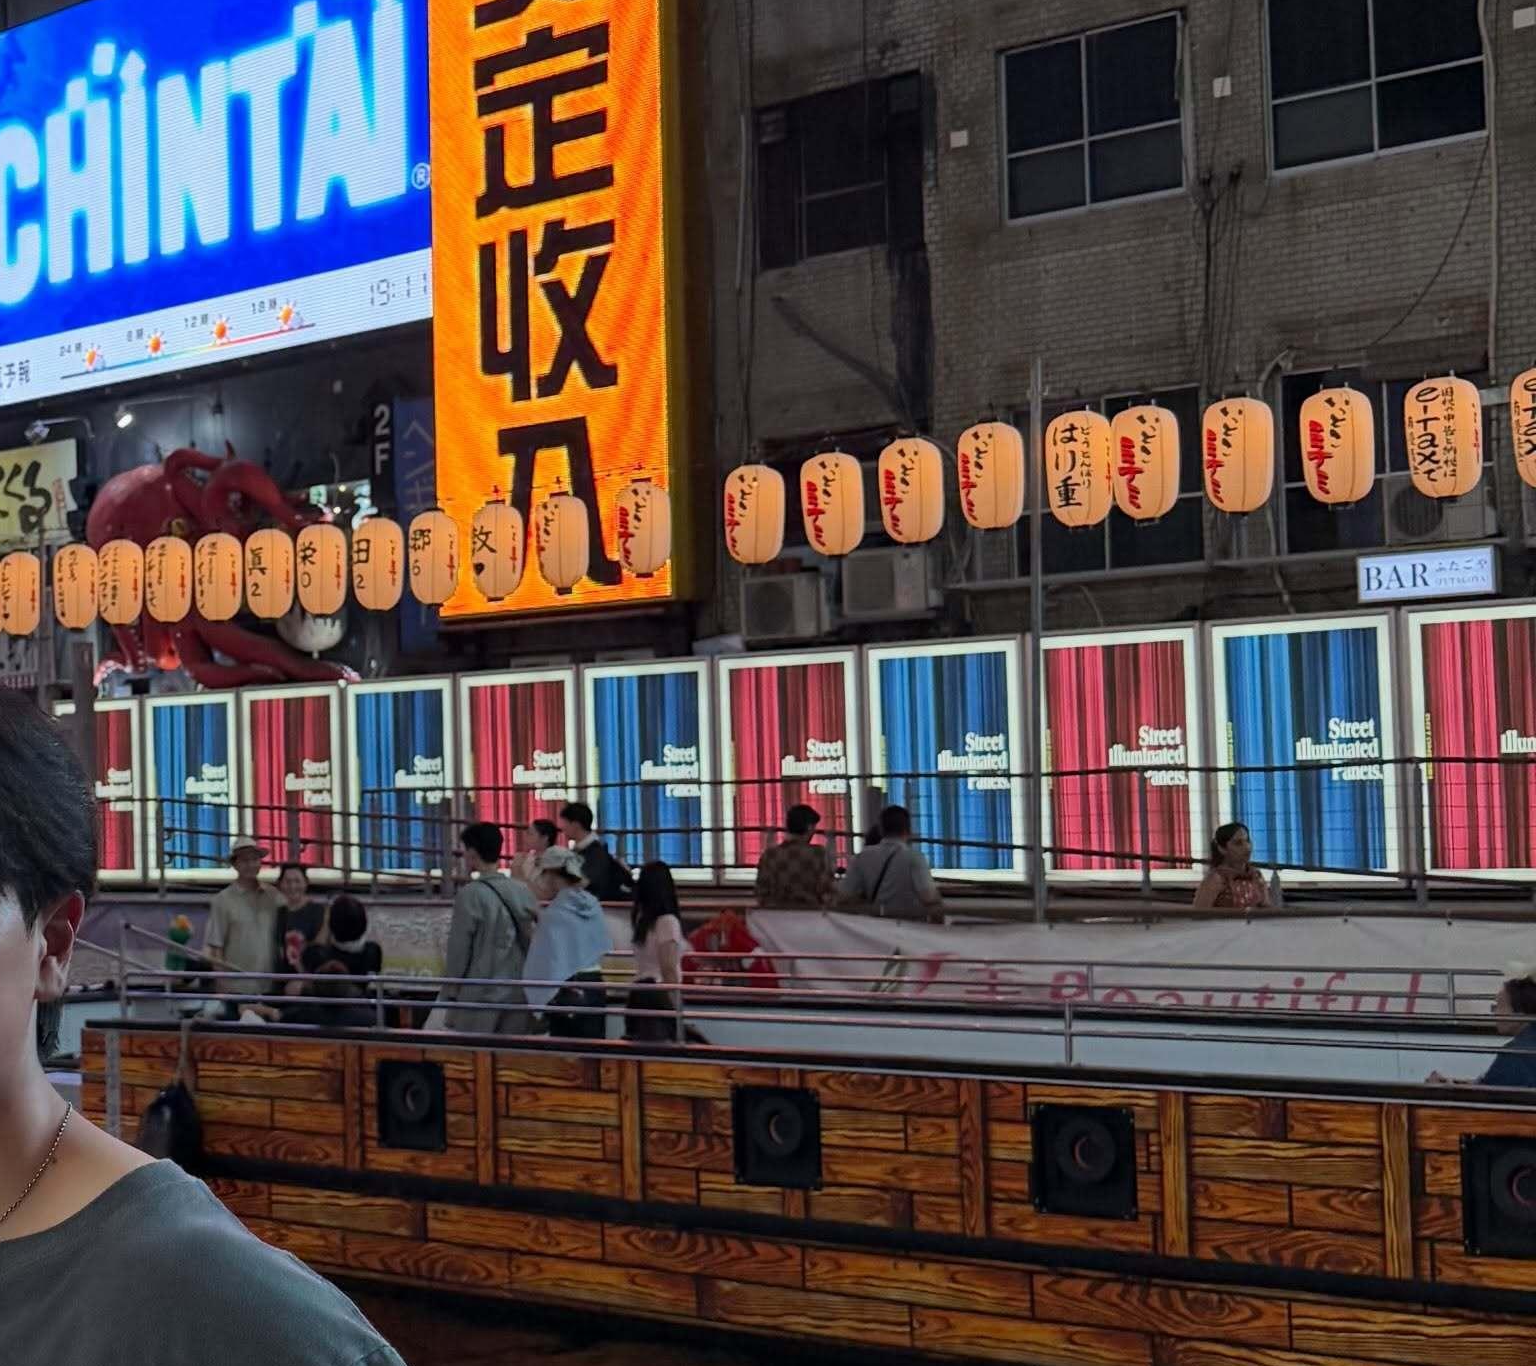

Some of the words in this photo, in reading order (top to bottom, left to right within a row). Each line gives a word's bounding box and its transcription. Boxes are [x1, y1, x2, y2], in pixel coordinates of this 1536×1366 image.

[373, 404, 391, 475] 2F
[1052, 422, 1082, 509] はり重
[352, 538, 371, 565] 田
[1363, 562, 1430, 592] BAR
[1139, 725, 1182, 747] Street
[1328, 717, 1375, 740] Street
[965, 732, 1004, 752] Street
[1296, 737, 1379, 761] Illuminated
[1109, 743, 1185, 767] Illuminated
